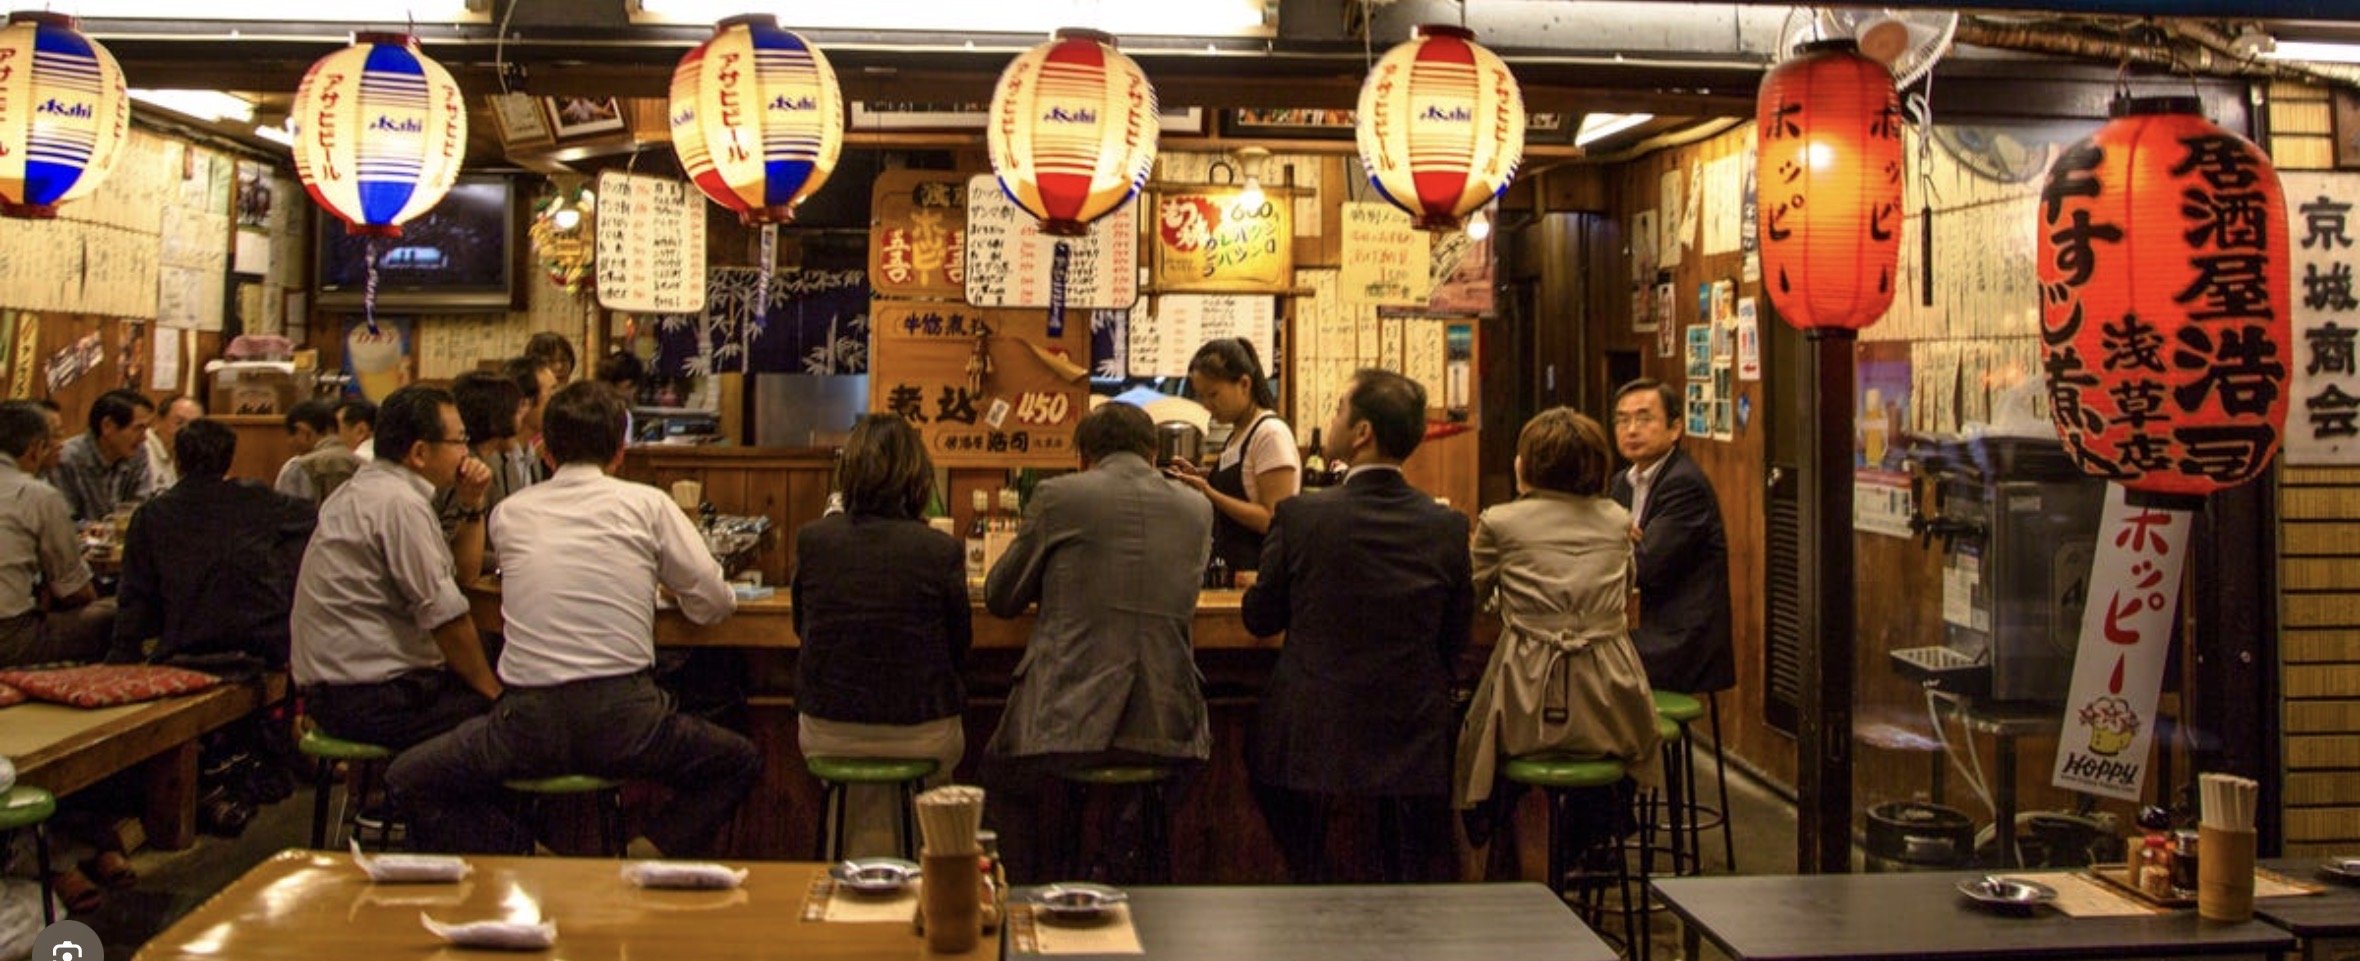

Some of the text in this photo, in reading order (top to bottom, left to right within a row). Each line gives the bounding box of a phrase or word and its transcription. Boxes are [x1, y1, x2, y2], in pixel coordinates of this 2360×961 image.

[37, 98, 93, 119] Asahi
[318, 73, 344, 182] アサヒビール
[368, 115, 422, 133] Asahi
[718, 53, 749, 162] アサヒビール
[769, 94, 817, 111] Asahi
[1043, 106, 1096, 124] Asahi
[1419, 105, 1472, 122] Asahi
[1764, 95, 1805, 295] ホッピー
[1870, 97, 1904, 295] ホッピー
[2168, 132, 2287, 482] 居酒屋浩司
[2299, 195, 2360, 440] 京城商会
[1016, 392, 1069, 424] 450
[2101, 312, 2172, 474] 浅草店
[2104, 507, 2172, 696] ホッピー
